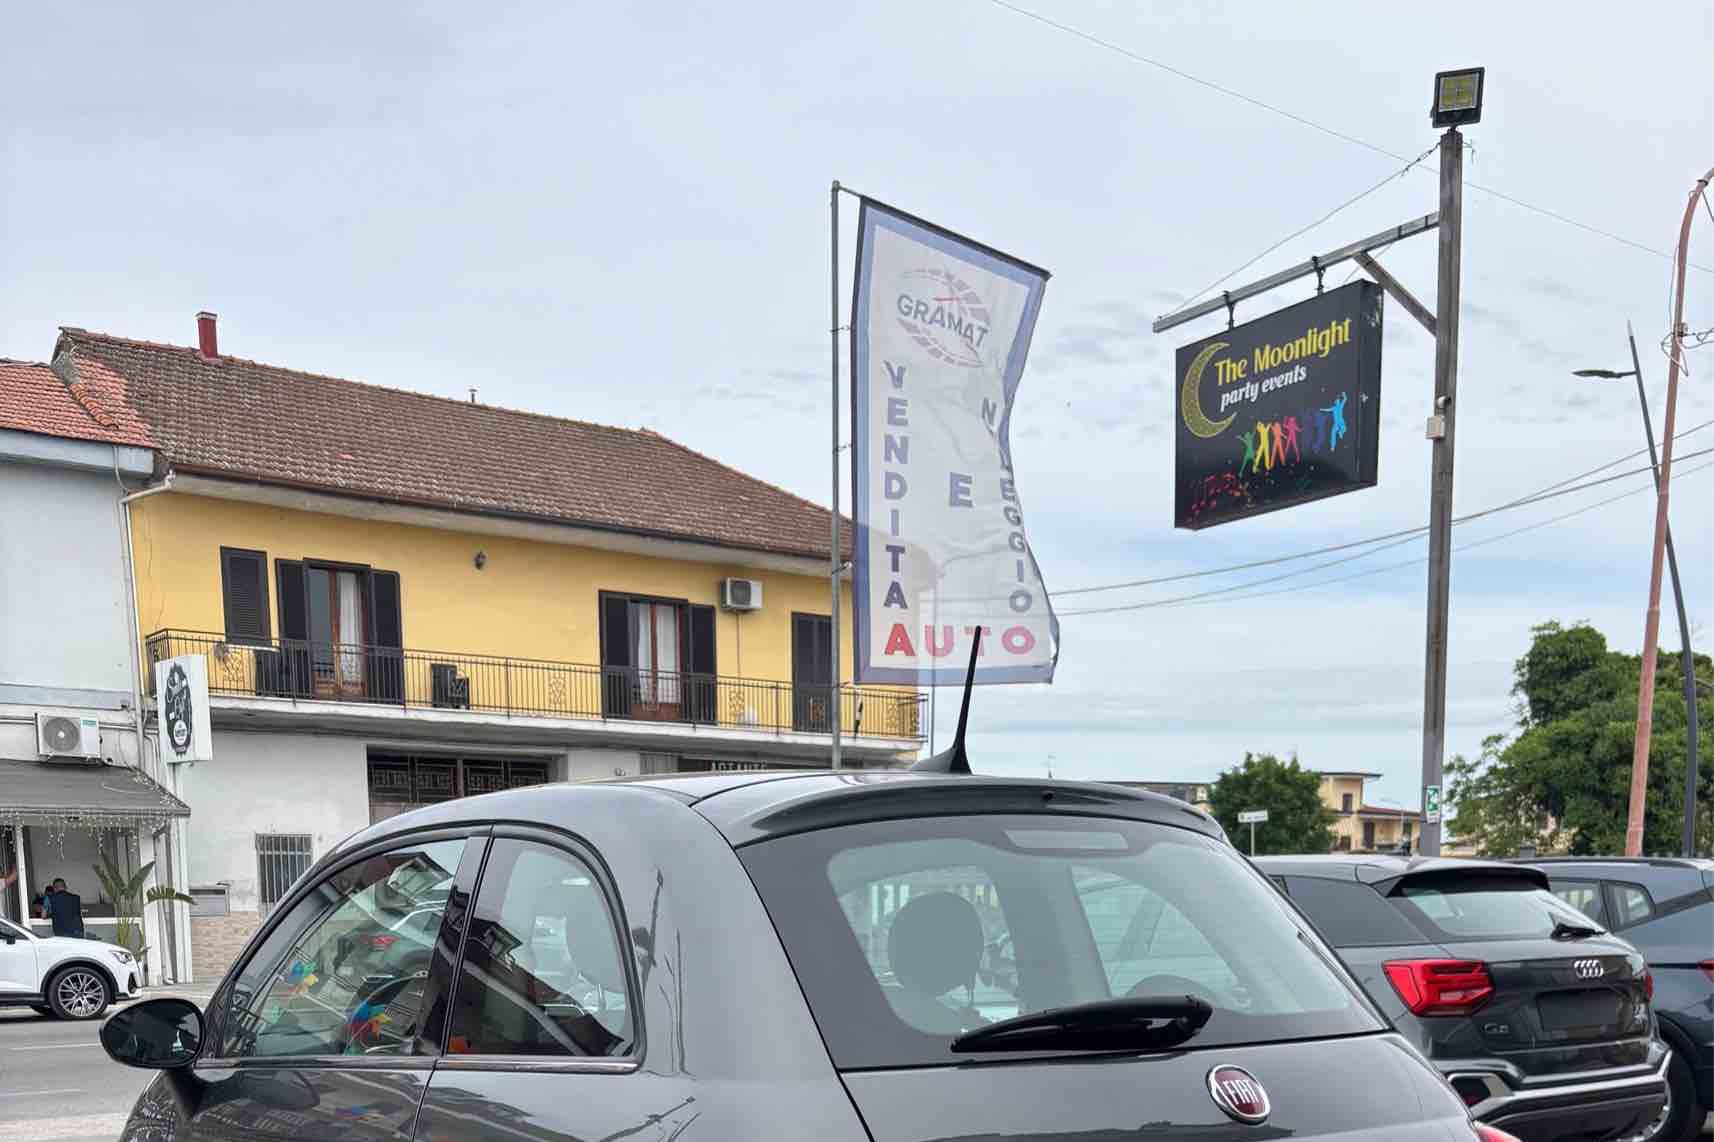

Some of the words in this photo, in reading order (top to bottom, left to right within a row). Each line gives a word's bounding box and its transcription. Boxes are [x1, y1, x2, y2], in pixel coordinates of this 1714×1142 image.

[898, 293, 989, 349] GRAMAT
[1215, 356, 1248, 386] The
[1254, 318, 1351, 374] Moonlight
[1220, 381, 1259, 412] party
[1262, 364, 1307, 394] events
[882, 359, 910, 610] VENDITA
[949, 472, 973, 508] E
[884, 623, 1036, 657] AUTO
[1223, 1079, 1260, 1105] FIAT
